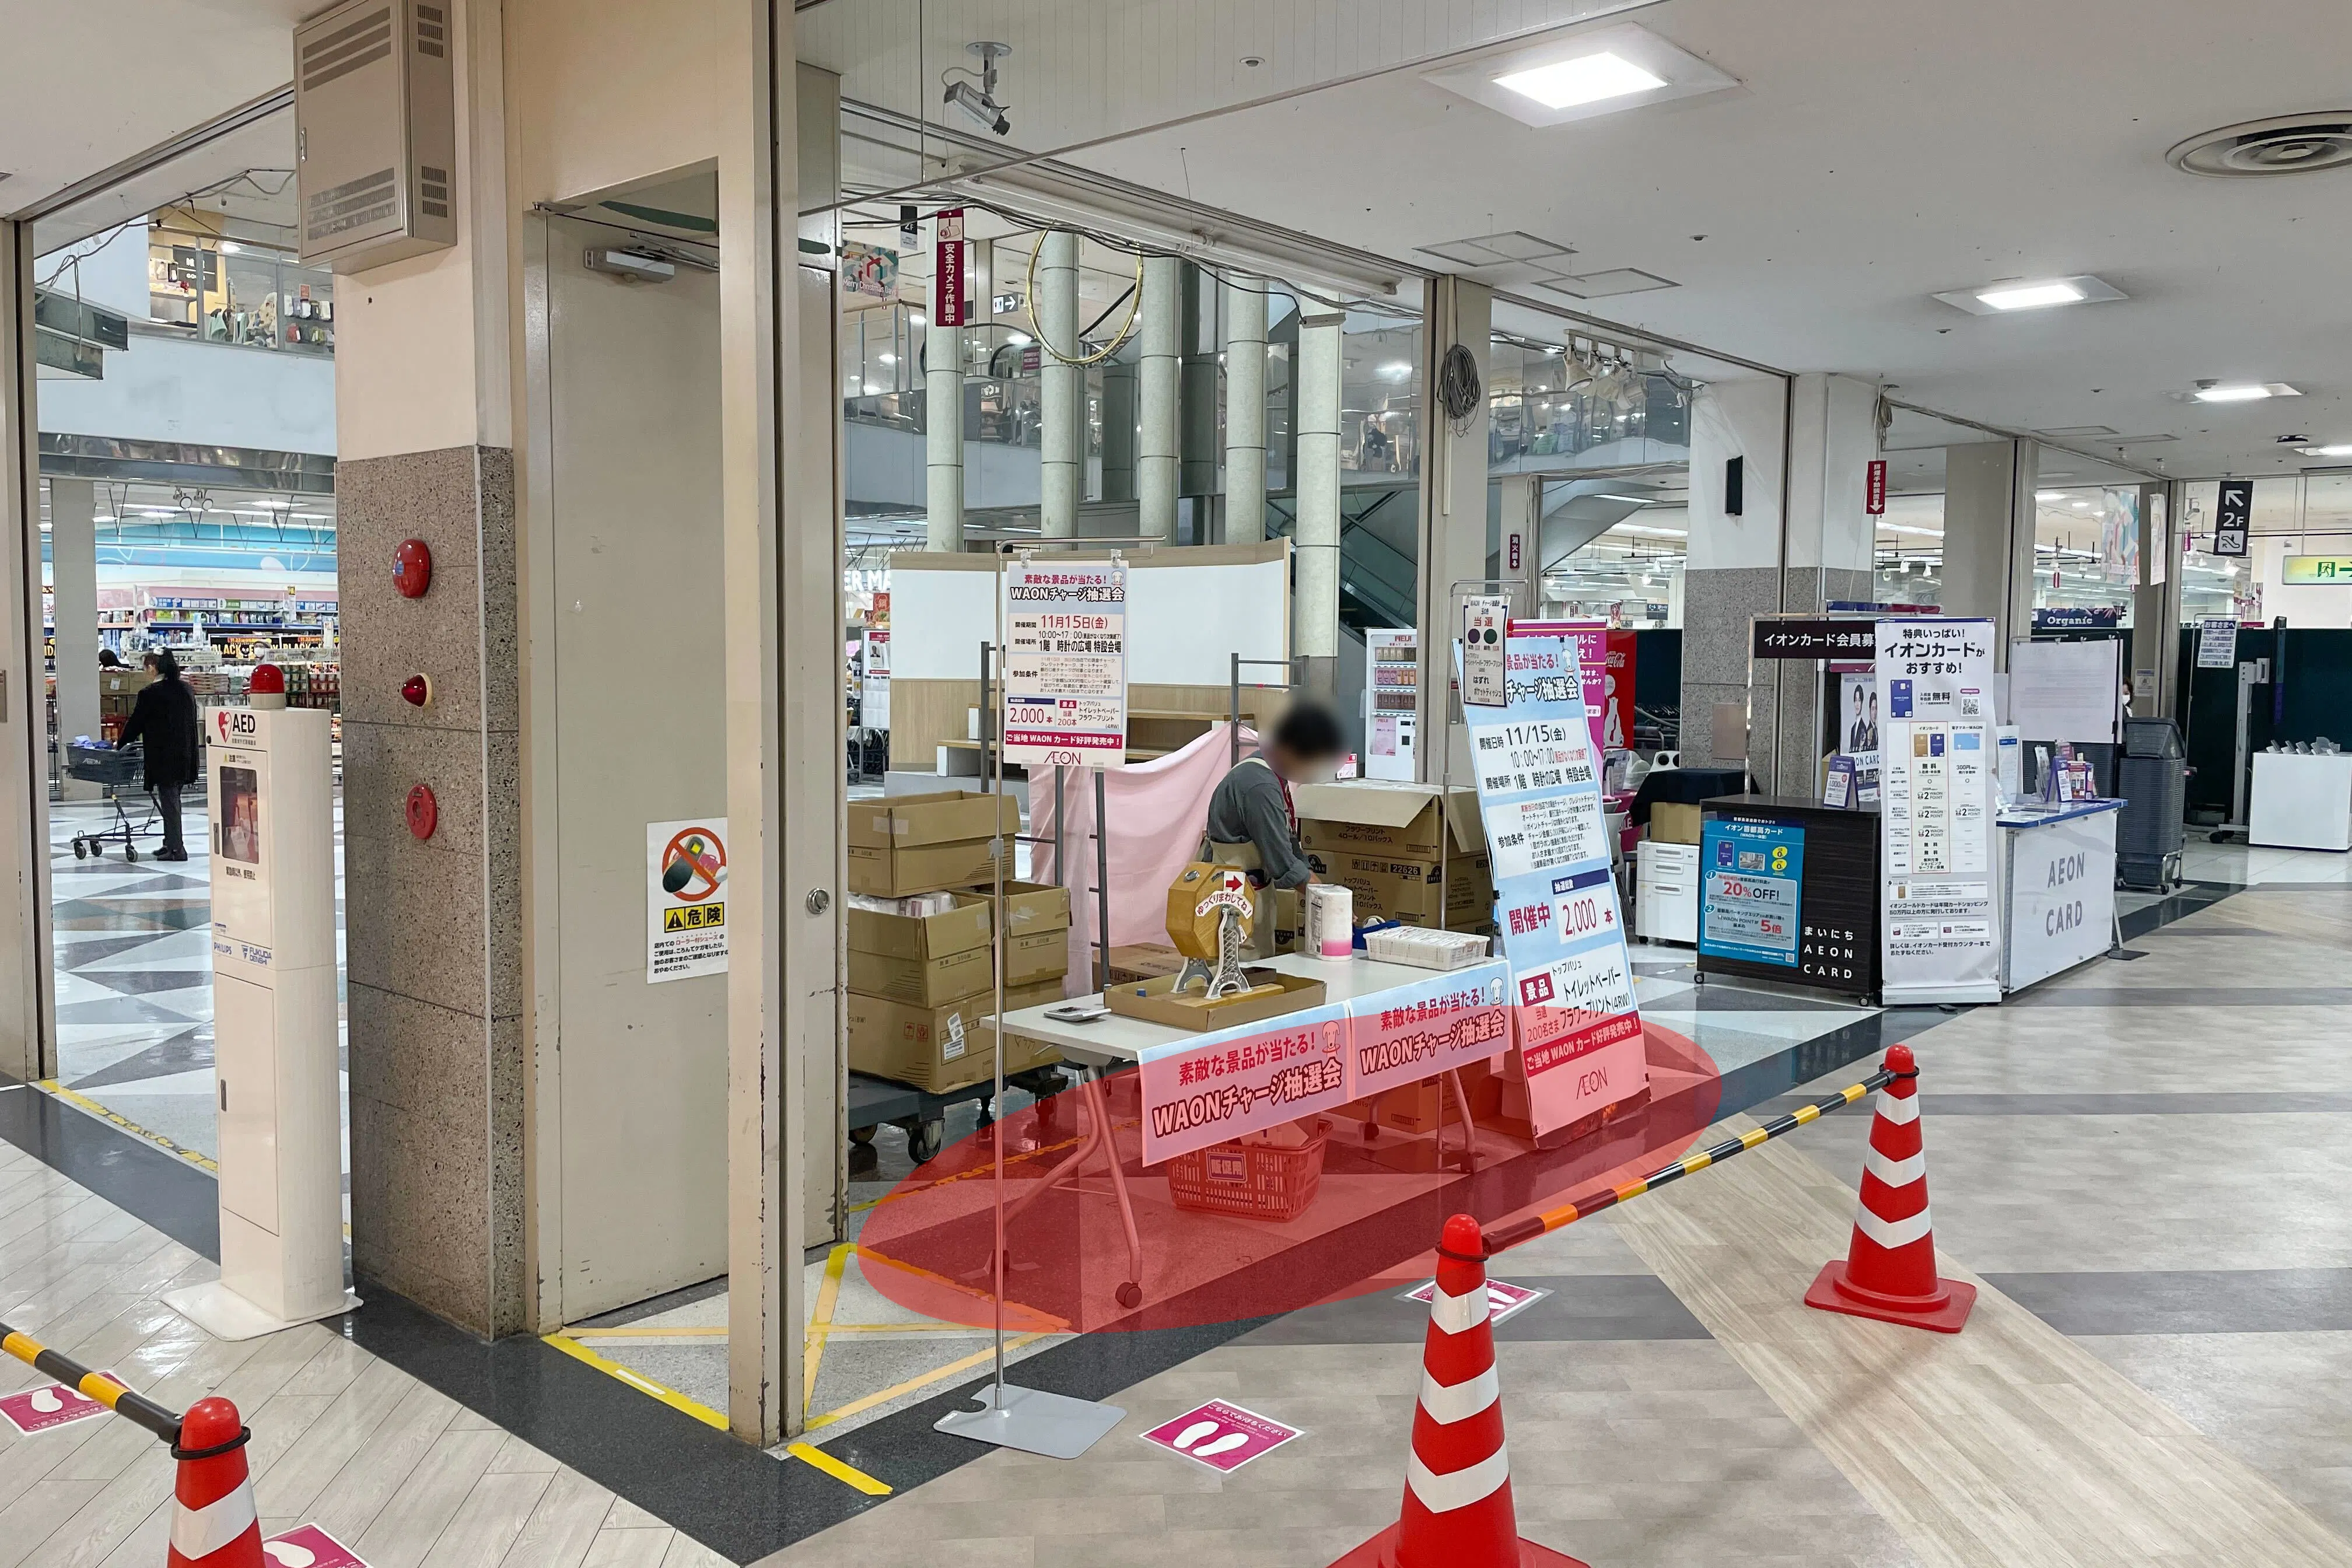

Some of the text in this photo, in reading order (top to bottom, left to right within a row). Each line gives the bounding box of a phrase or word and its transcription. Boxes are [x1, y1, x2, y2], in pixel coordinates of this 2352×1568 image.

[945, 243, 955, 324] 安全カメラ作動中
[2223, 512, 2244, 527] 2F
[1025, 574, 1107, 584] 素敵な景品が当たる!
[1010, 587, 1125, 602] WAONチャージ抽選会
[1041, 615, 1108, 629] 11月15日(金)
[1474, 617, 1493, 626] 当選
[1765, 634, 1875, 646] イオンカード会員募
[1903, 629, 1965, 639] 特典いっぱい!
[1040, 641, 1121, 653] 1階 時計の広場 特設会場
[1885, 642, 1985, 657] イオンカードが
[1906, 662, 1962, 674] おすすめ!
[1474, 688, 1502, 697] ポケットティッシュ
[1506, 676, 1579, 704] チャージ抽選会
[1933, 692, 1950, 701] 無料
[233, 714, 256, 733] AED
[1010, 708, 1044, 724] 2,000
[1058, 718, 1076, 726] 200本
[1006, 734, 1028, 743] ご当地
[1480, 736, 1504, 749] 開催日時
[1506, 724, 1566, 746] 11/15(金)
[1486, 768, 1592, 790] 開催場所 1階 時計の広場 特設会場
[1345, 825, 1385, 834] フラワープリント
[1725, 824, 1783, 835] イオン首都高カード
[1339, 832, 1393, 843] 4ロール/10パック入
[1498, 832, 1525, 849] 参加条件
[1392, 864, 1418, 874] 22626
[2048, 852, 2085, 888] AEON
[1344, 877, 1371, 885] トップバリュ
[1723, 881, 1752, 898] 20%
[1753, 887, 1780, 901] OFF!
[1356, 902, 1382, 910] 10パック入
[687, 906, 722, 926] 危険
[1509, 902, 1550, 936] 開催中
[1563, 898, 1614, 937] 2,000 本
[2046, 900, 2082, 937] CARD
[1804, 926, 1853, 942] まいにち
[214, 942, 232, 955] PHILIPS
[250, 947, 272, 960] FUKUDA
[1804, 944, 1853, 959] AEON
[250, 955, 267, 965] DENSHI
[654, 964, 690, 974] おやめください。
[1552, 959, 1583, 977] トップバリュ
[1803, 964, 1852, 979] CARD
[1525, 981, 1549, 1002] 景品
[1563, 966, 1621, 1002] トイレットペーパー
[1380, 986, 1486, 1031] 素敵な景品が当たる!
[1527, 1019, 1560, 1042] 200名さま
[1360, 1009, 1506, 1077] WAONチャージ抽選会
[1179, 1031, 1316, 1087] 素敵な景品が当たる!
[1527, 1051, 1550, 1072] ご当地
[1550, 1043, 1574, 1060] WAON
[1153, 1057, 1343, 1139] WAONチャージ抽選会
